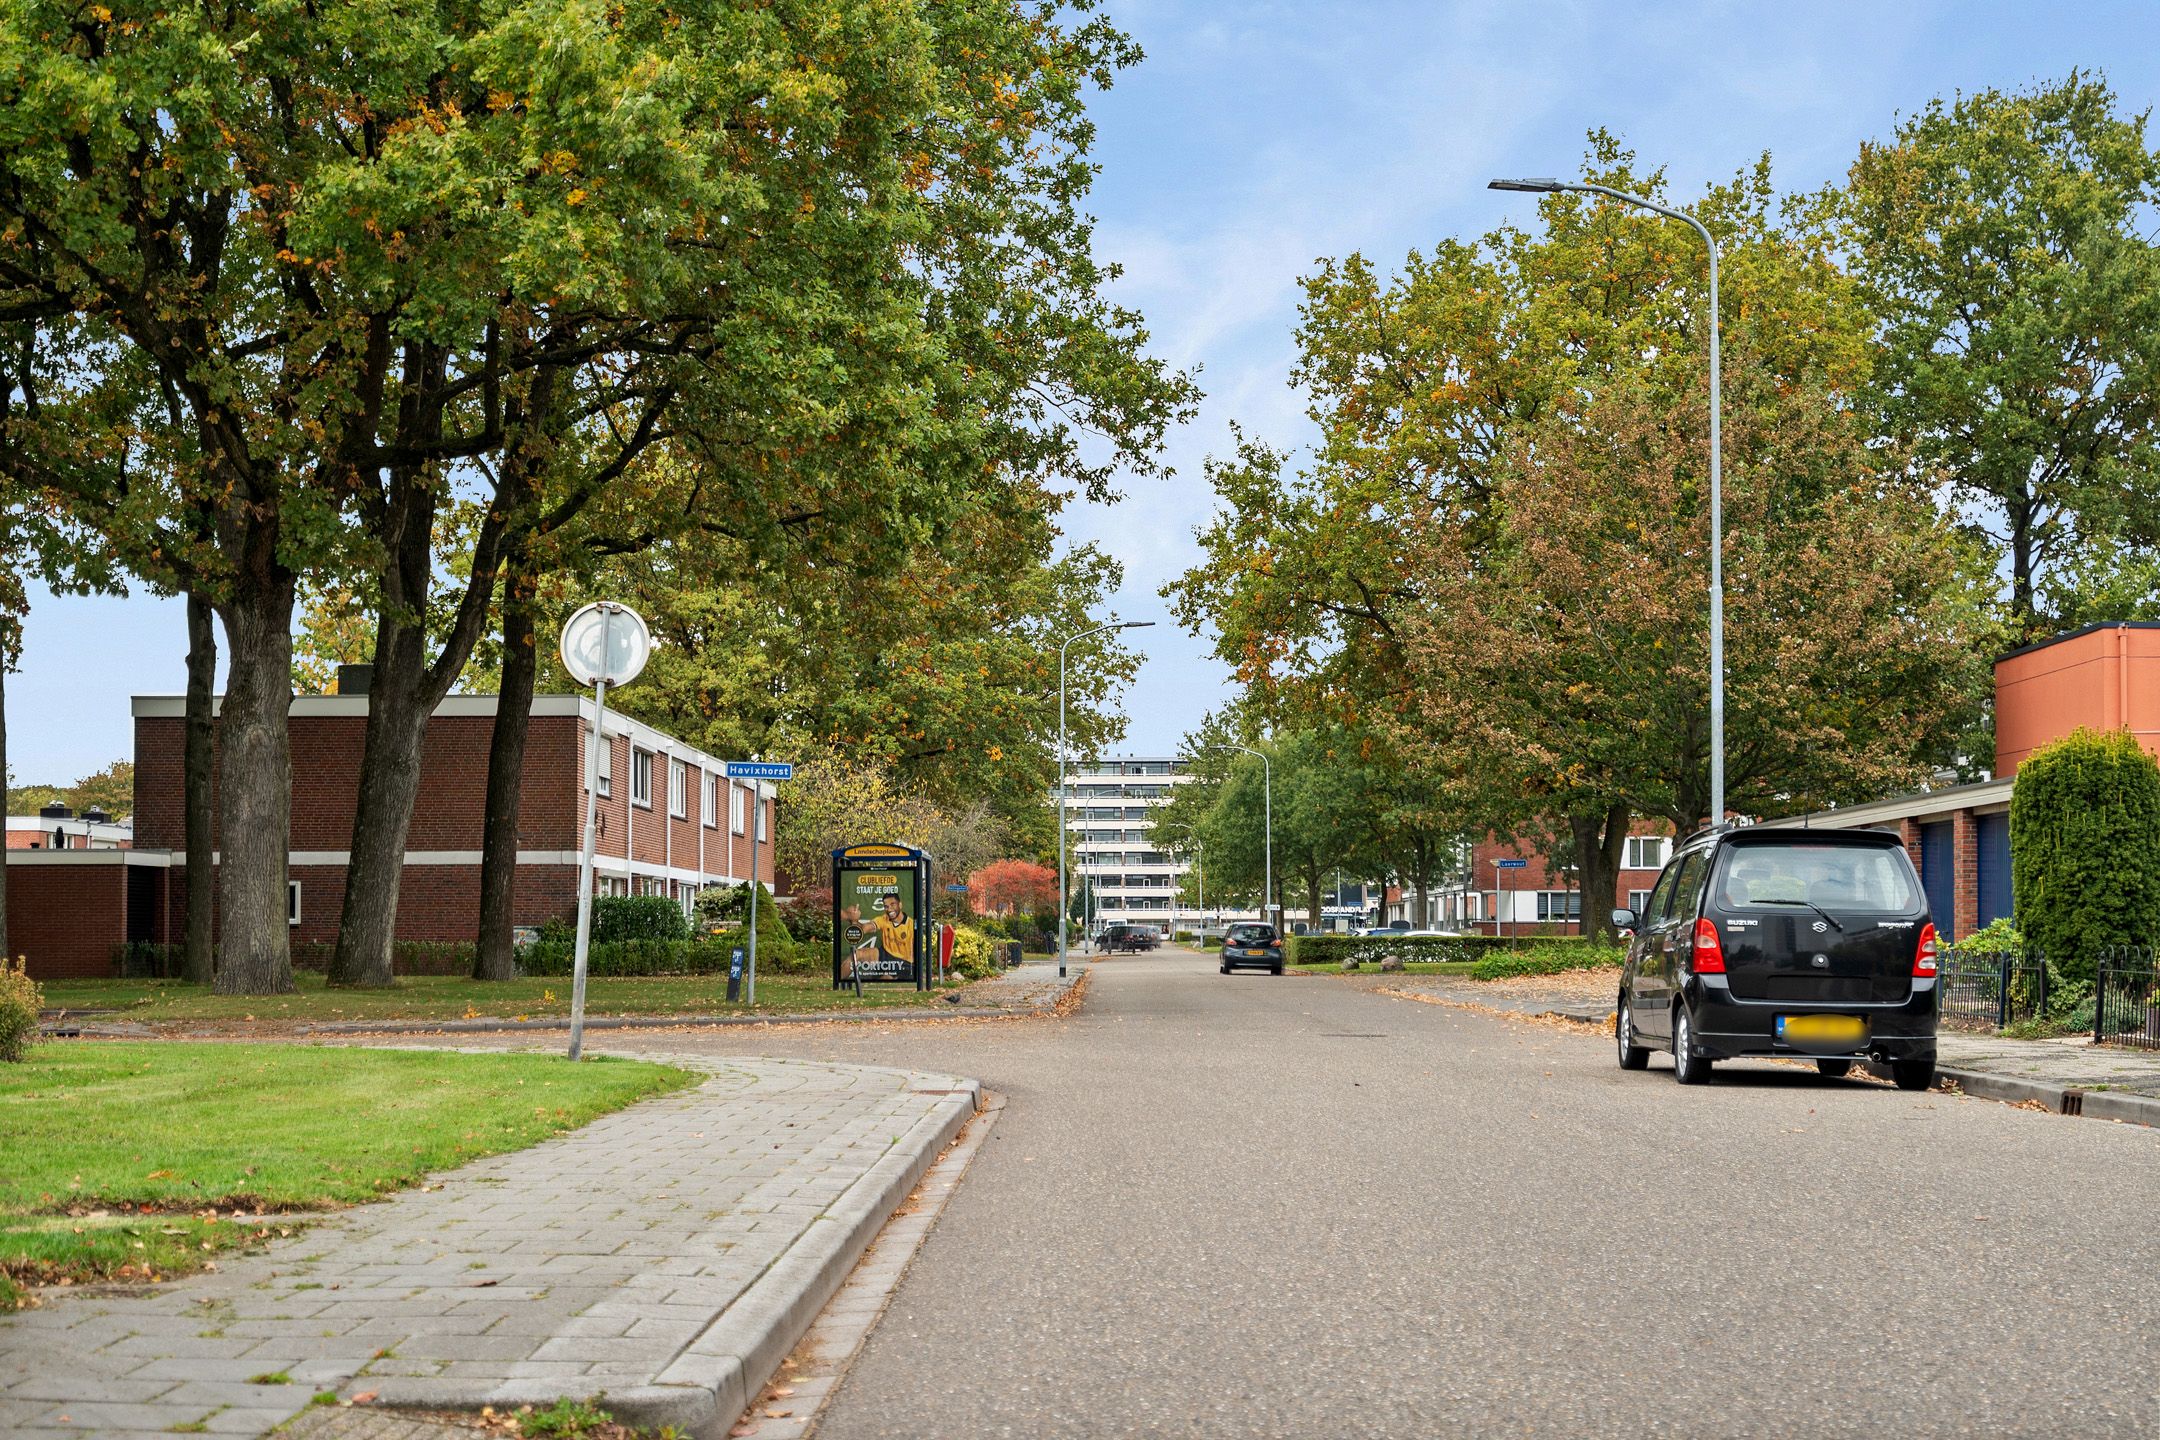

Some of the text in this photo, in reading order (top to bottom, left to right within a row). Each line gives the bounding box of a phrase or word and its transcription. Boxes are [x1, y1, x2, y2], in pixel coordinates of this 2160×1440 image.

[730, 766, 789, 775] Havixhorst
[860, 876, 895, 884] CLUBLIEFDE
[856, 886, 899, 894] STAAT JE GOED
